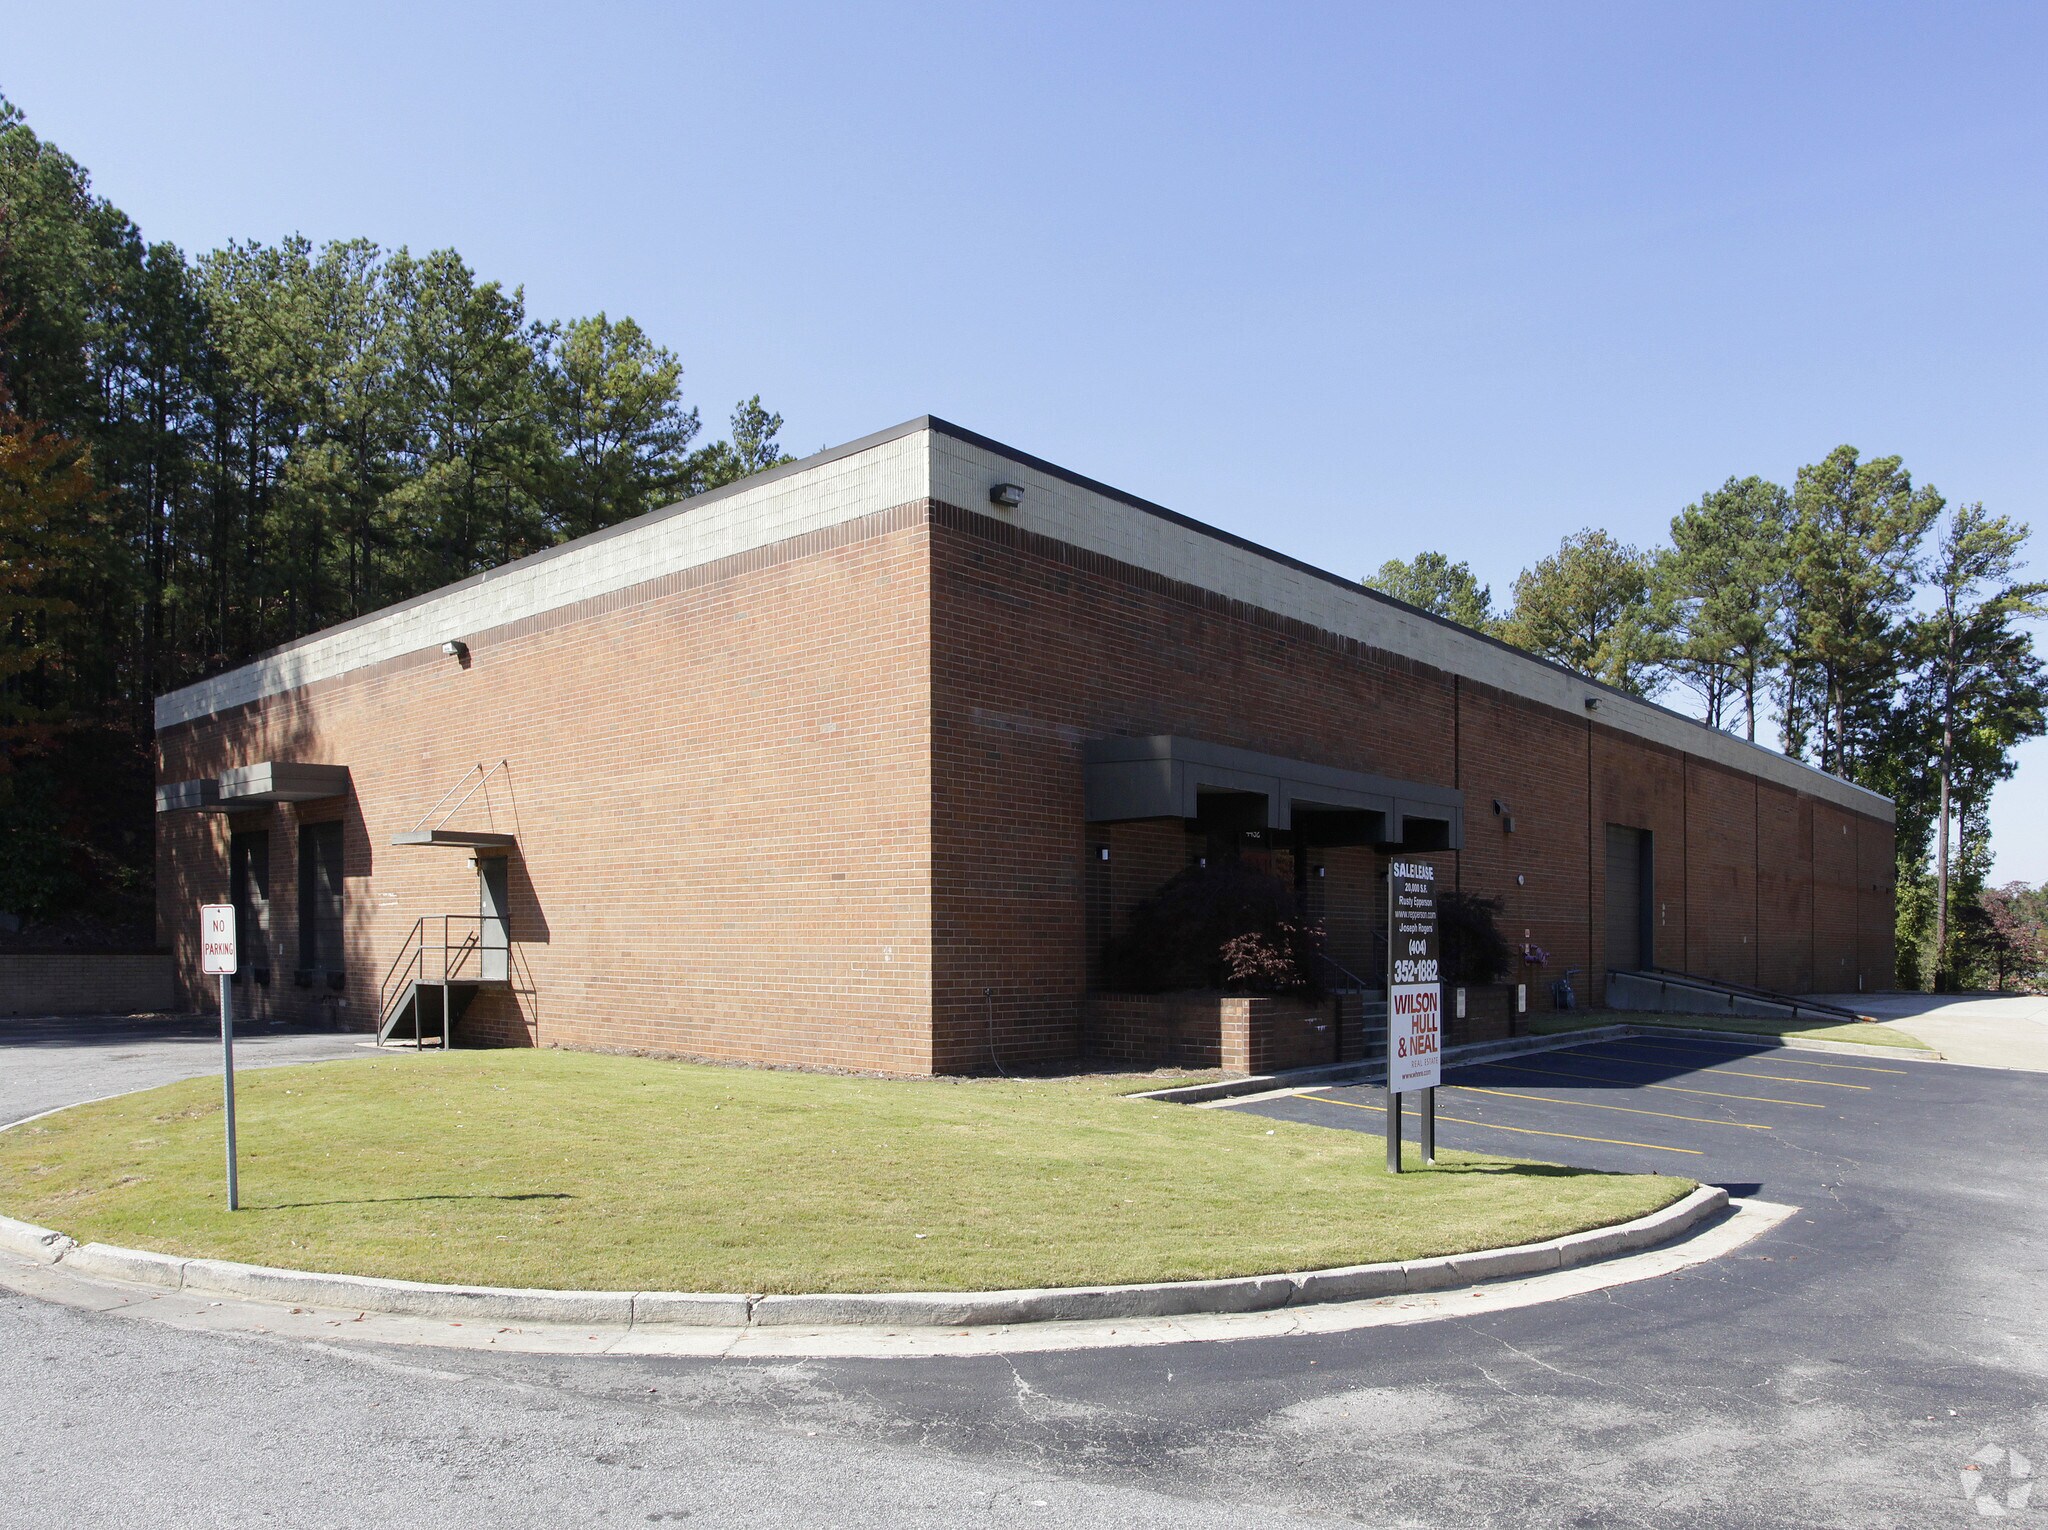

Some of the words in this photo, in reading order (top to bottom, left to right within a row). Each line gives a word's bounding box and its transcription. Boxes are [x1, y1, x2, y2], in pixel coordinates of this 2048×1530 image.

[1399, 895, 1413, 907] Rusty
[1414, 896, 1433, 908] Epperson
[212, 920, 225, 932] NO
[1399, 922, 1417, 934] Joseph
[205, 943, 234, 955] PARKING
[1408, 938, 1427, 956] (404)
[1394, 959, 1438, 983] 352-1882
[1394, 992, 1437, 1015] WILSON
[1411, 1013, 1438, 1035] HULL
[1398, 1037, 1407, 1058] &
[1409, 1034, 1438, 1056] NEAL
[1411, 1059, 1423, 1068] REAL
[1424, 1056, 1439, 1066] ESTATE
